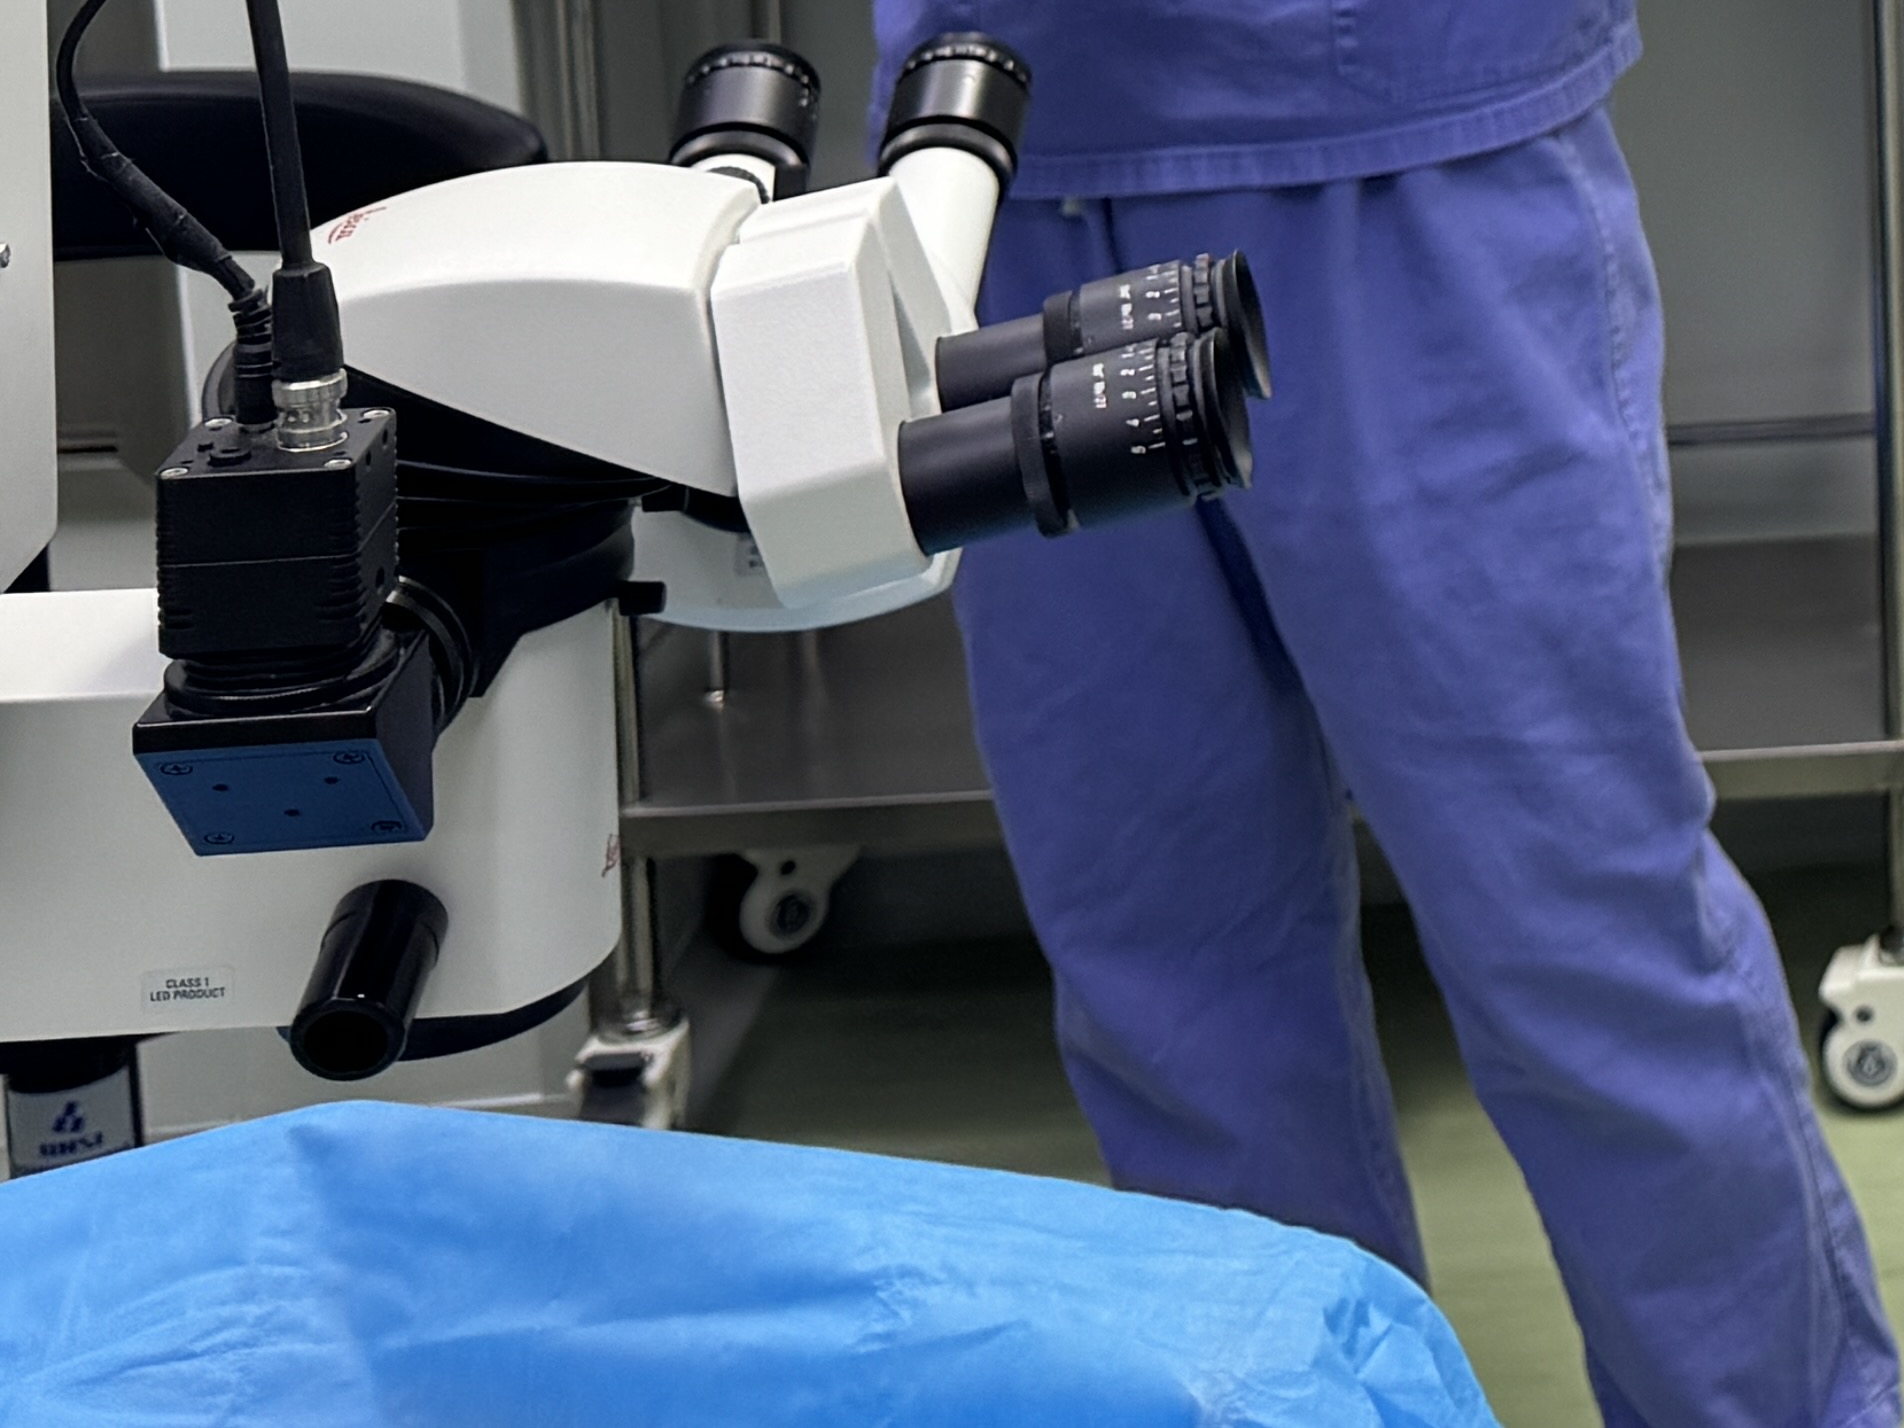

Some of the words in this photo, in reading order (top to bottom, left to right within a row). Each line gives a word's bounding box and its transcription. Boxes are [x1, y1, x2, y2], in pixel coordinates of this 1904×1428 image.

[165, 977, 202, 989] CLASS
[204, 976, 209, 987] 1
[150, 990, 171, 1002] LED
[172, 987, 226, 1001] PRODUCT
